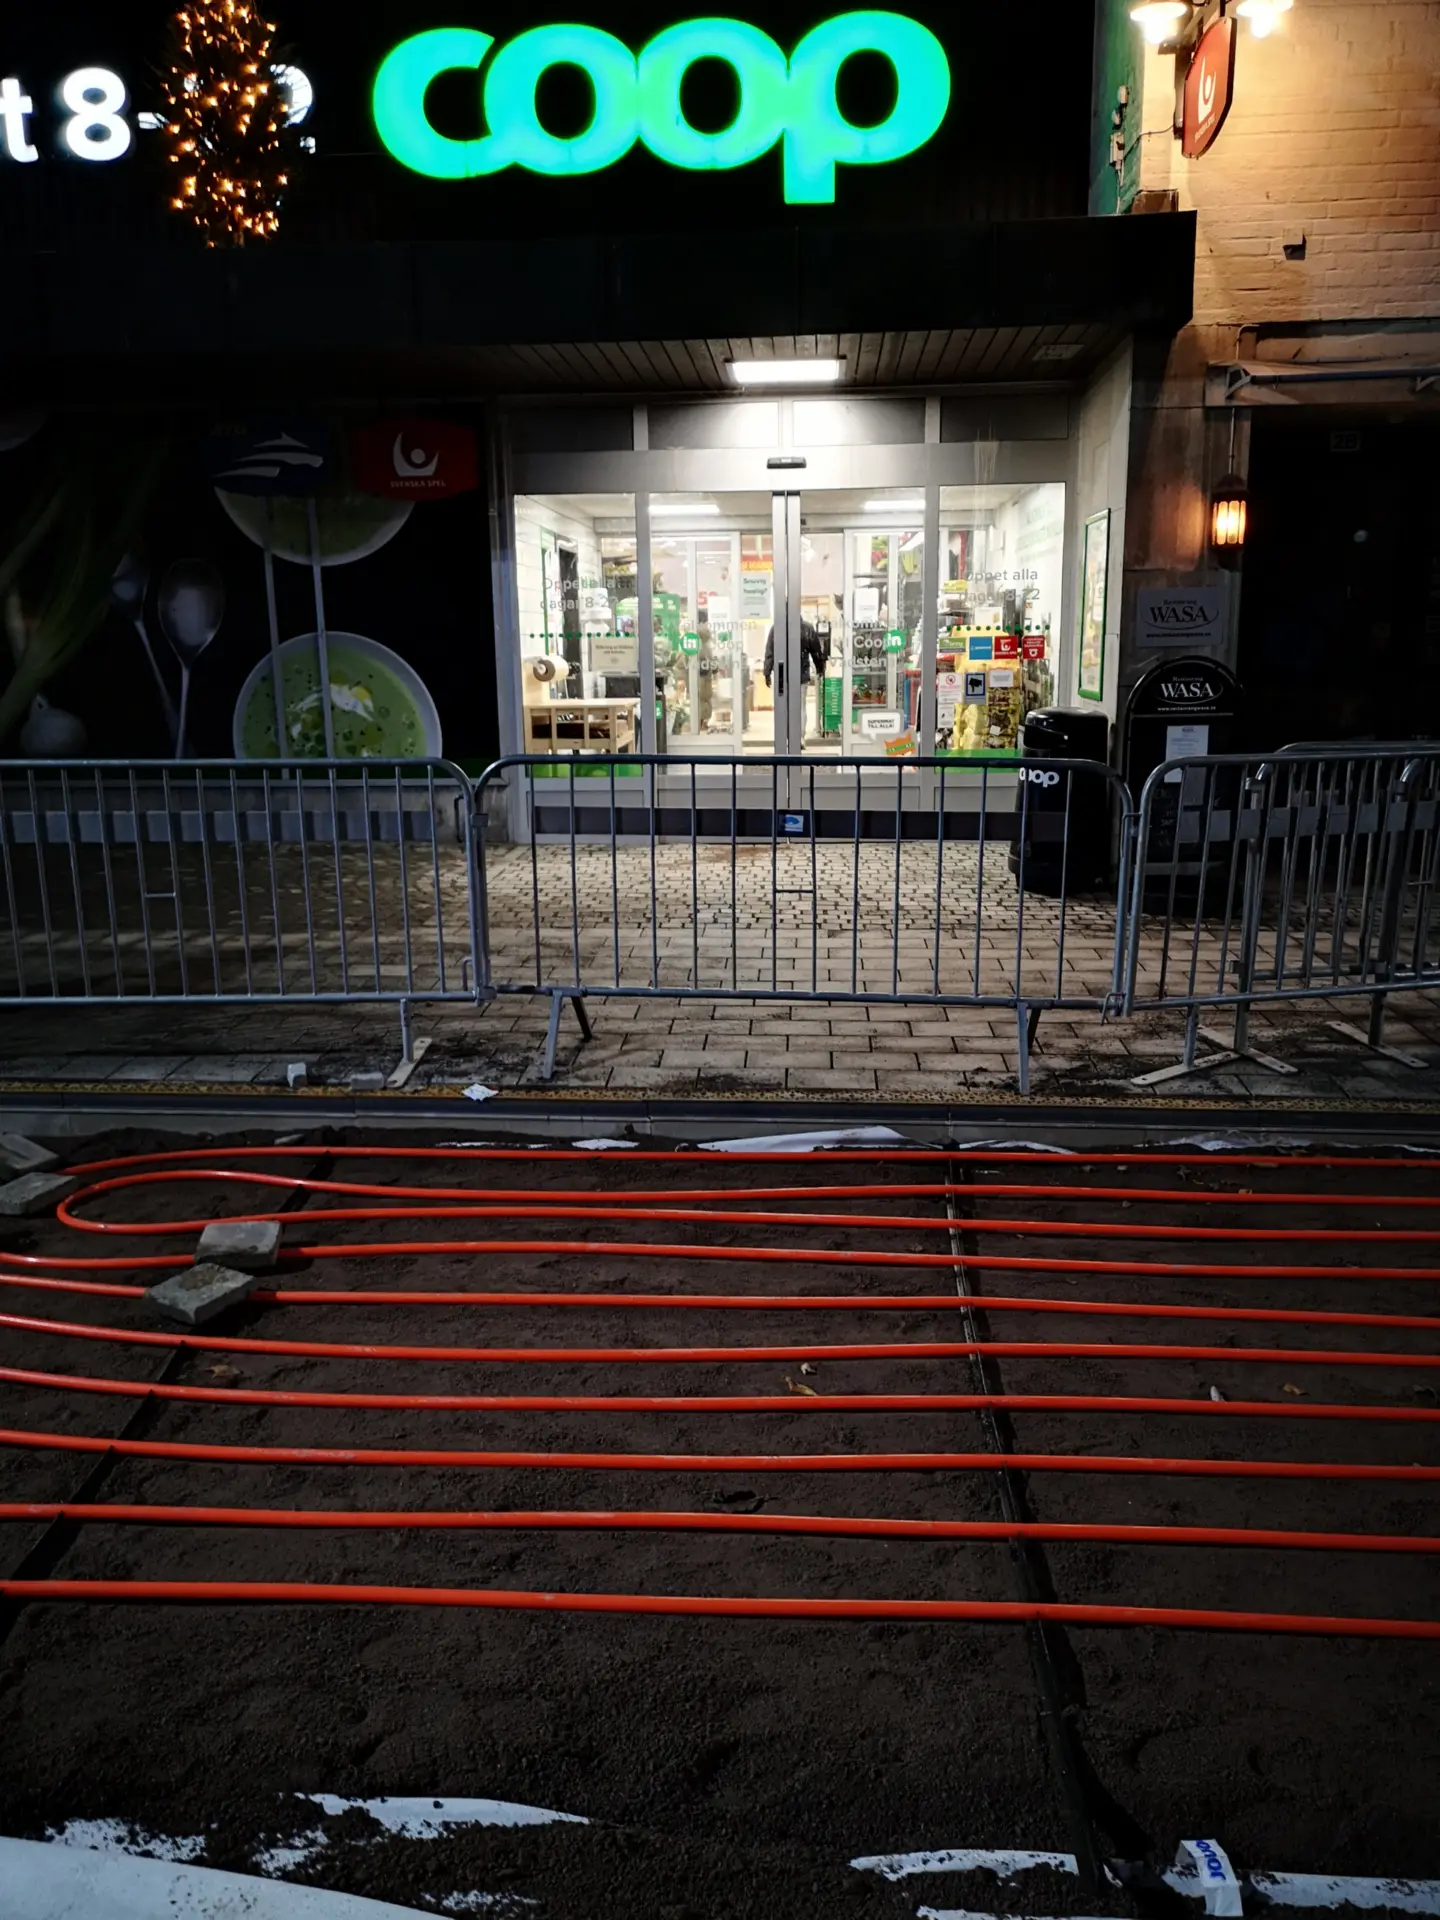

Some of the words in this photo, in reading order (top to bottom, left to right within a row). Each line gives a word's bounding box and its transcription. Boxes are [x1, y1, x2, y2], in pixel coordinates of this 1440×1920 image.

[372, 10, 952, 205] coop
[390, 479, 426, 489] SVENSKA
[427, 478, 447, 488] SPEL
[1012, 568, 1038, 581] alla
[1149, 606, 1209, 624] WASA
[1160, 682, 1214, 698] WASA
